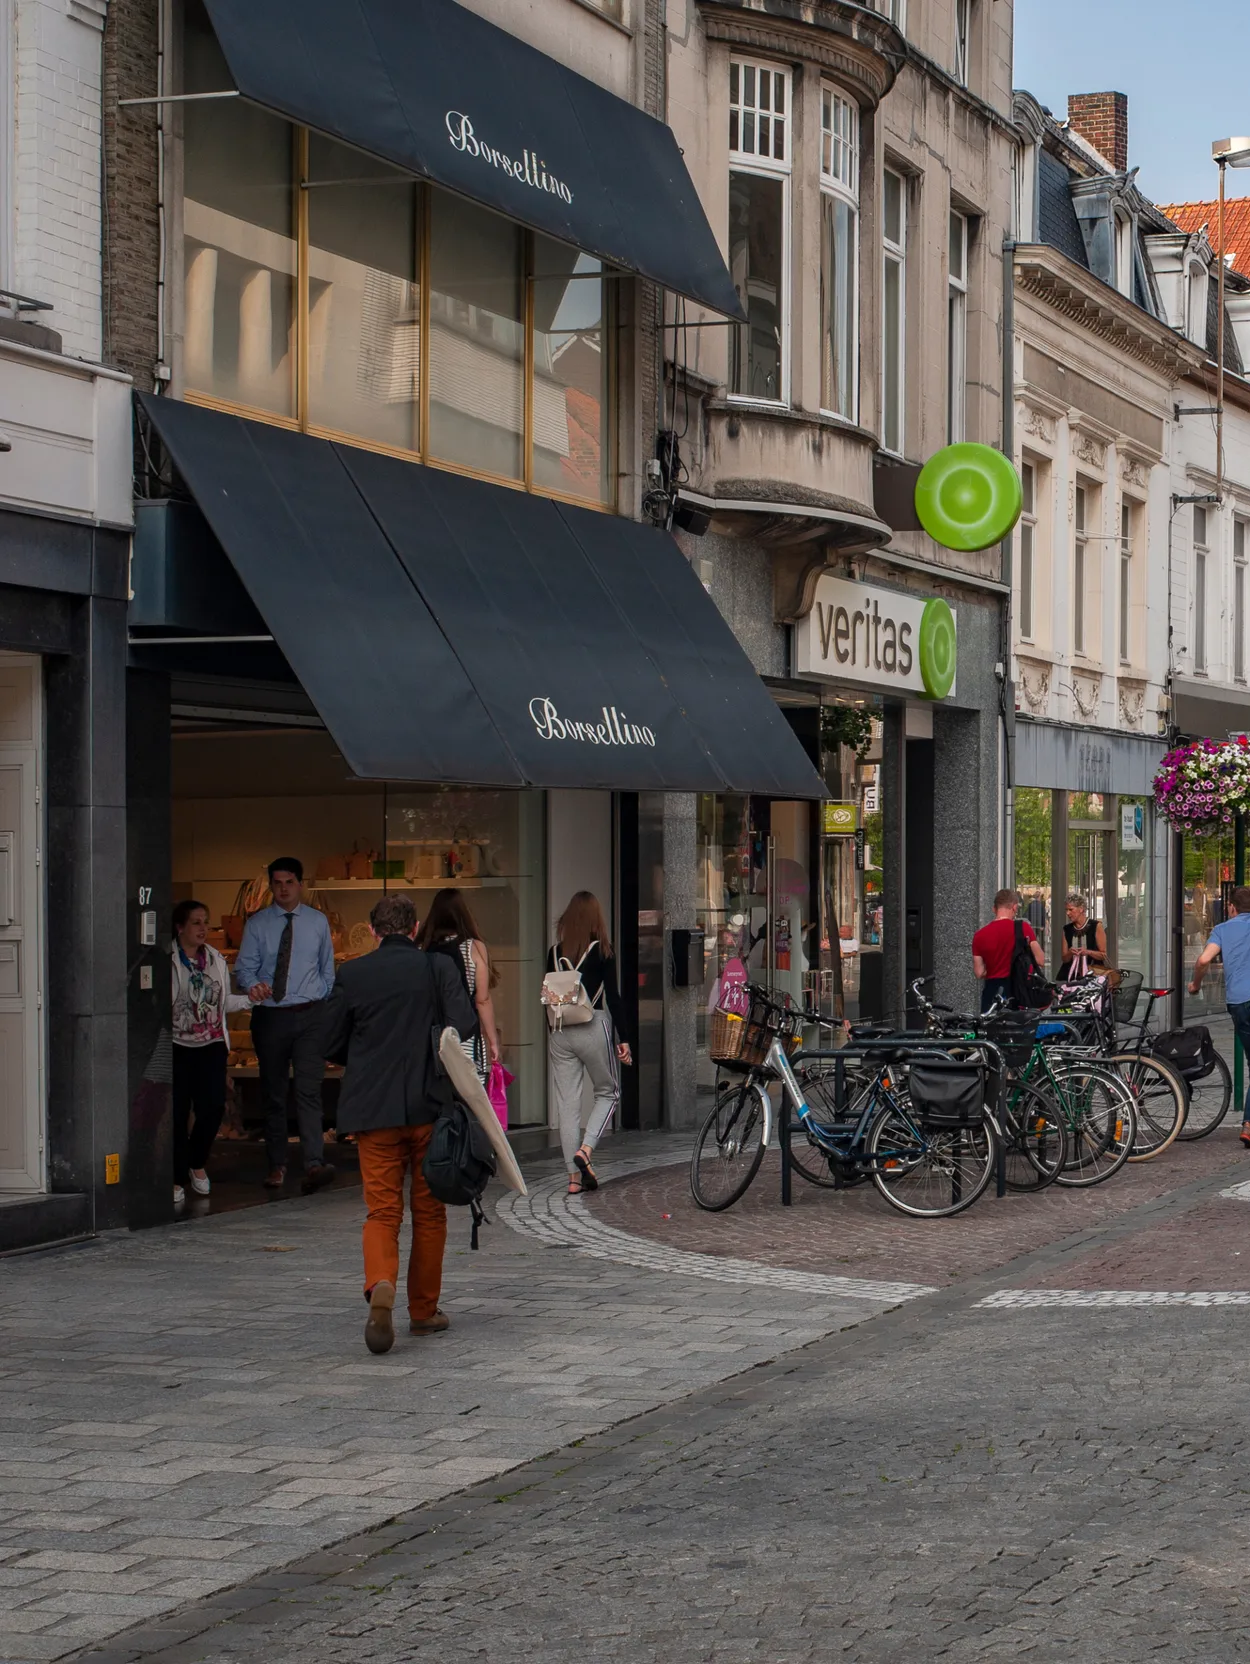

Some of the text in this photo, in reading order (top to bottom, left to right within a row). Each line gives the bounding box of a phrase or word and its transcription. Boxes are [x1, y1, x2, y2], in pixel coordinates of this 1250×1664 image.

[446, 110, 573, 204] Borsellino
[816, 598, 912, 676] veritas
[529, 697, 656, 747] Borsellino
[139, 886, 152, 905] 87
